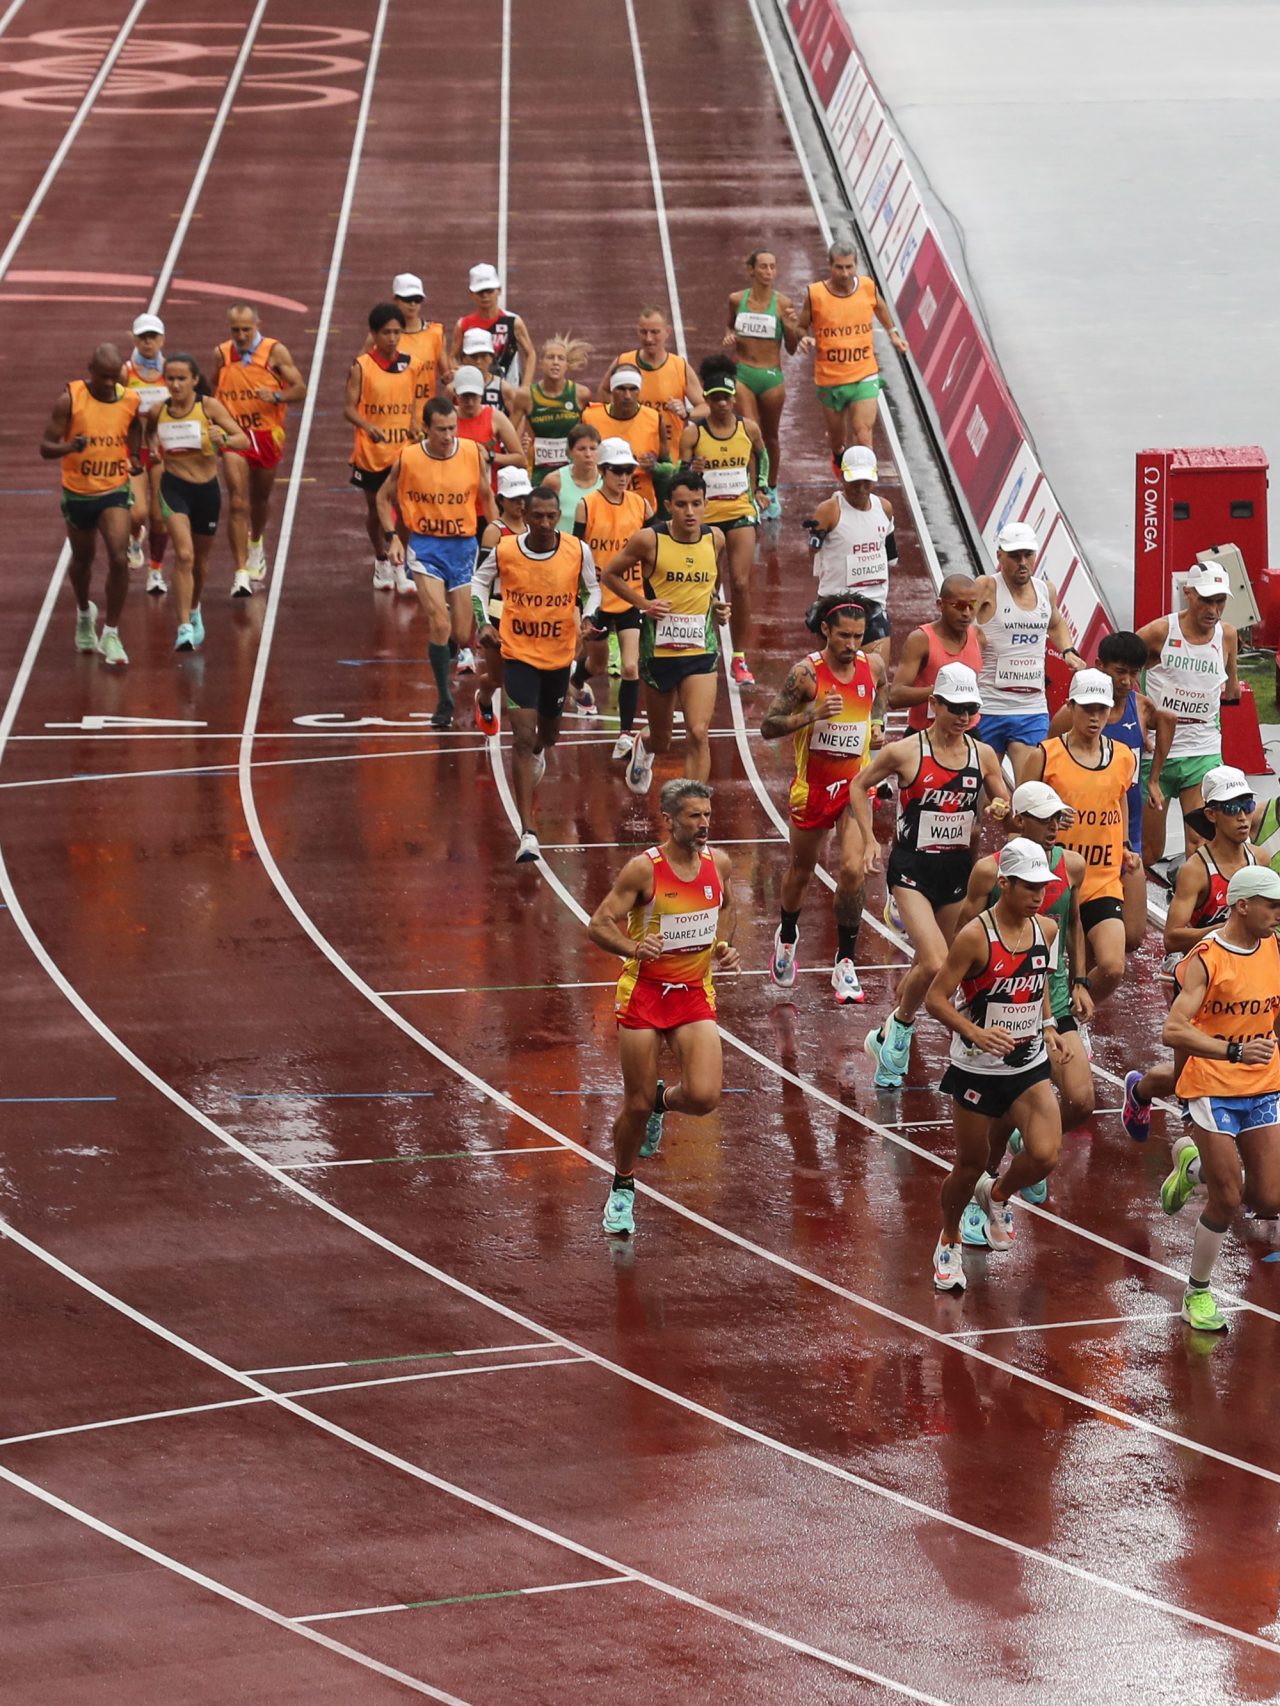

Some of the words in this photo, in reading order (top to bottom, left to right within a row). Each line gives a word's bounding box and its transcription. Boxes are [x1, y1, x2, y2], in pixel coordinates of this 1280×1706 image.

[742, 323, 767, 333] FIUZA
[819, 326, 852, 337] TOKYO
[827, 346, 870, 363] GUIDE
[364, 404, 400, 415] TOKYO
[536, 448, 565, 458] COETZ
[80, 459, 126, 477] GUIDE
[406, 490, 444, 505] TOKYO
[417, 517, 466, 535] GUIDE
[1144, 489, 1158, 553] OMEGA
[591, 538, 620, 551] OKYO
[853, 541, 880, 555] PERU
[858, 553, 881, 562] TOYOTA
[666, 571, 709, 583] BRASIL
[506, 589, 542, 607] TOKYO
[669, 615, 697, 624] TOYOTA
[512, 618, 563, 638] GUIDE
[659, 625, 703, 638] JACQUES
[1011, 633, 1039, 645] FRO
[1166, 654, 1219, 675] PORTUGAL
[999, 670, 1042, 680] VATNHAMAR
[1175, 687, 1206, 699] TOYOTA
[1162, 697, 1209, 713] MENDES
[827, 723, 858, 732] TOYOTA
[818, 732, 860, 748] NIEVES
[918, 787, 977, 807] JAPAN
[934, 814, 965, 822] TOYOTA
[930, 826, 963, 839] WADA
[675, 913, 709, 924] TOYOTA
[663, 929, 697, 940] SUAREZ
[986, 973, 1046, 996] JAPAN
[1003, 1005, 1036, 1014] TOYOTA
[1204, 999, 1261, 1015] TOKYO
